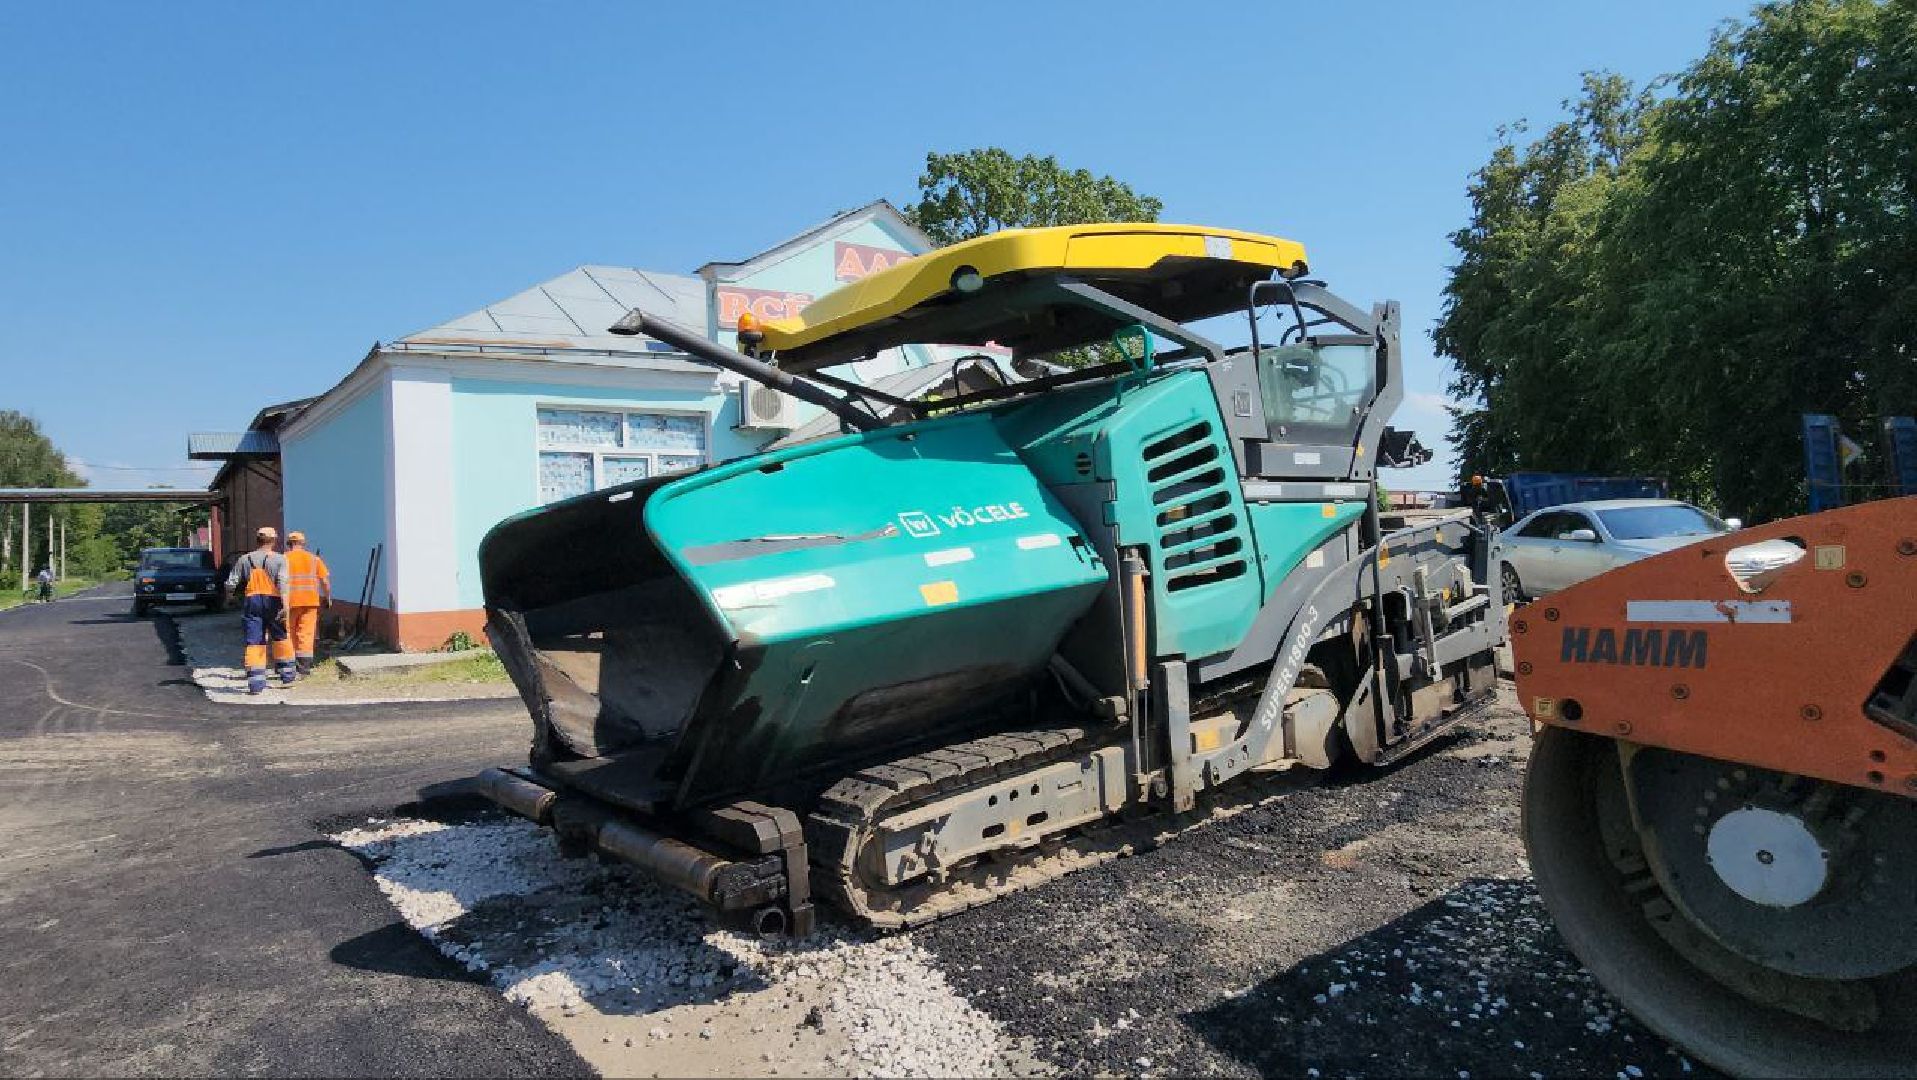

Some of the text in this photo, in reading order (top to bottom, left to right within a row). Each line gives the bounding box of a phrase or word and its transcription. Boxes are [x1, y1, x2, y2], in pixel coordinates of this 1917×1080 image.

[1261, 605, 1318, 731] SUPER 1800-3
[1560, 626, 1708, 669] HAMM
